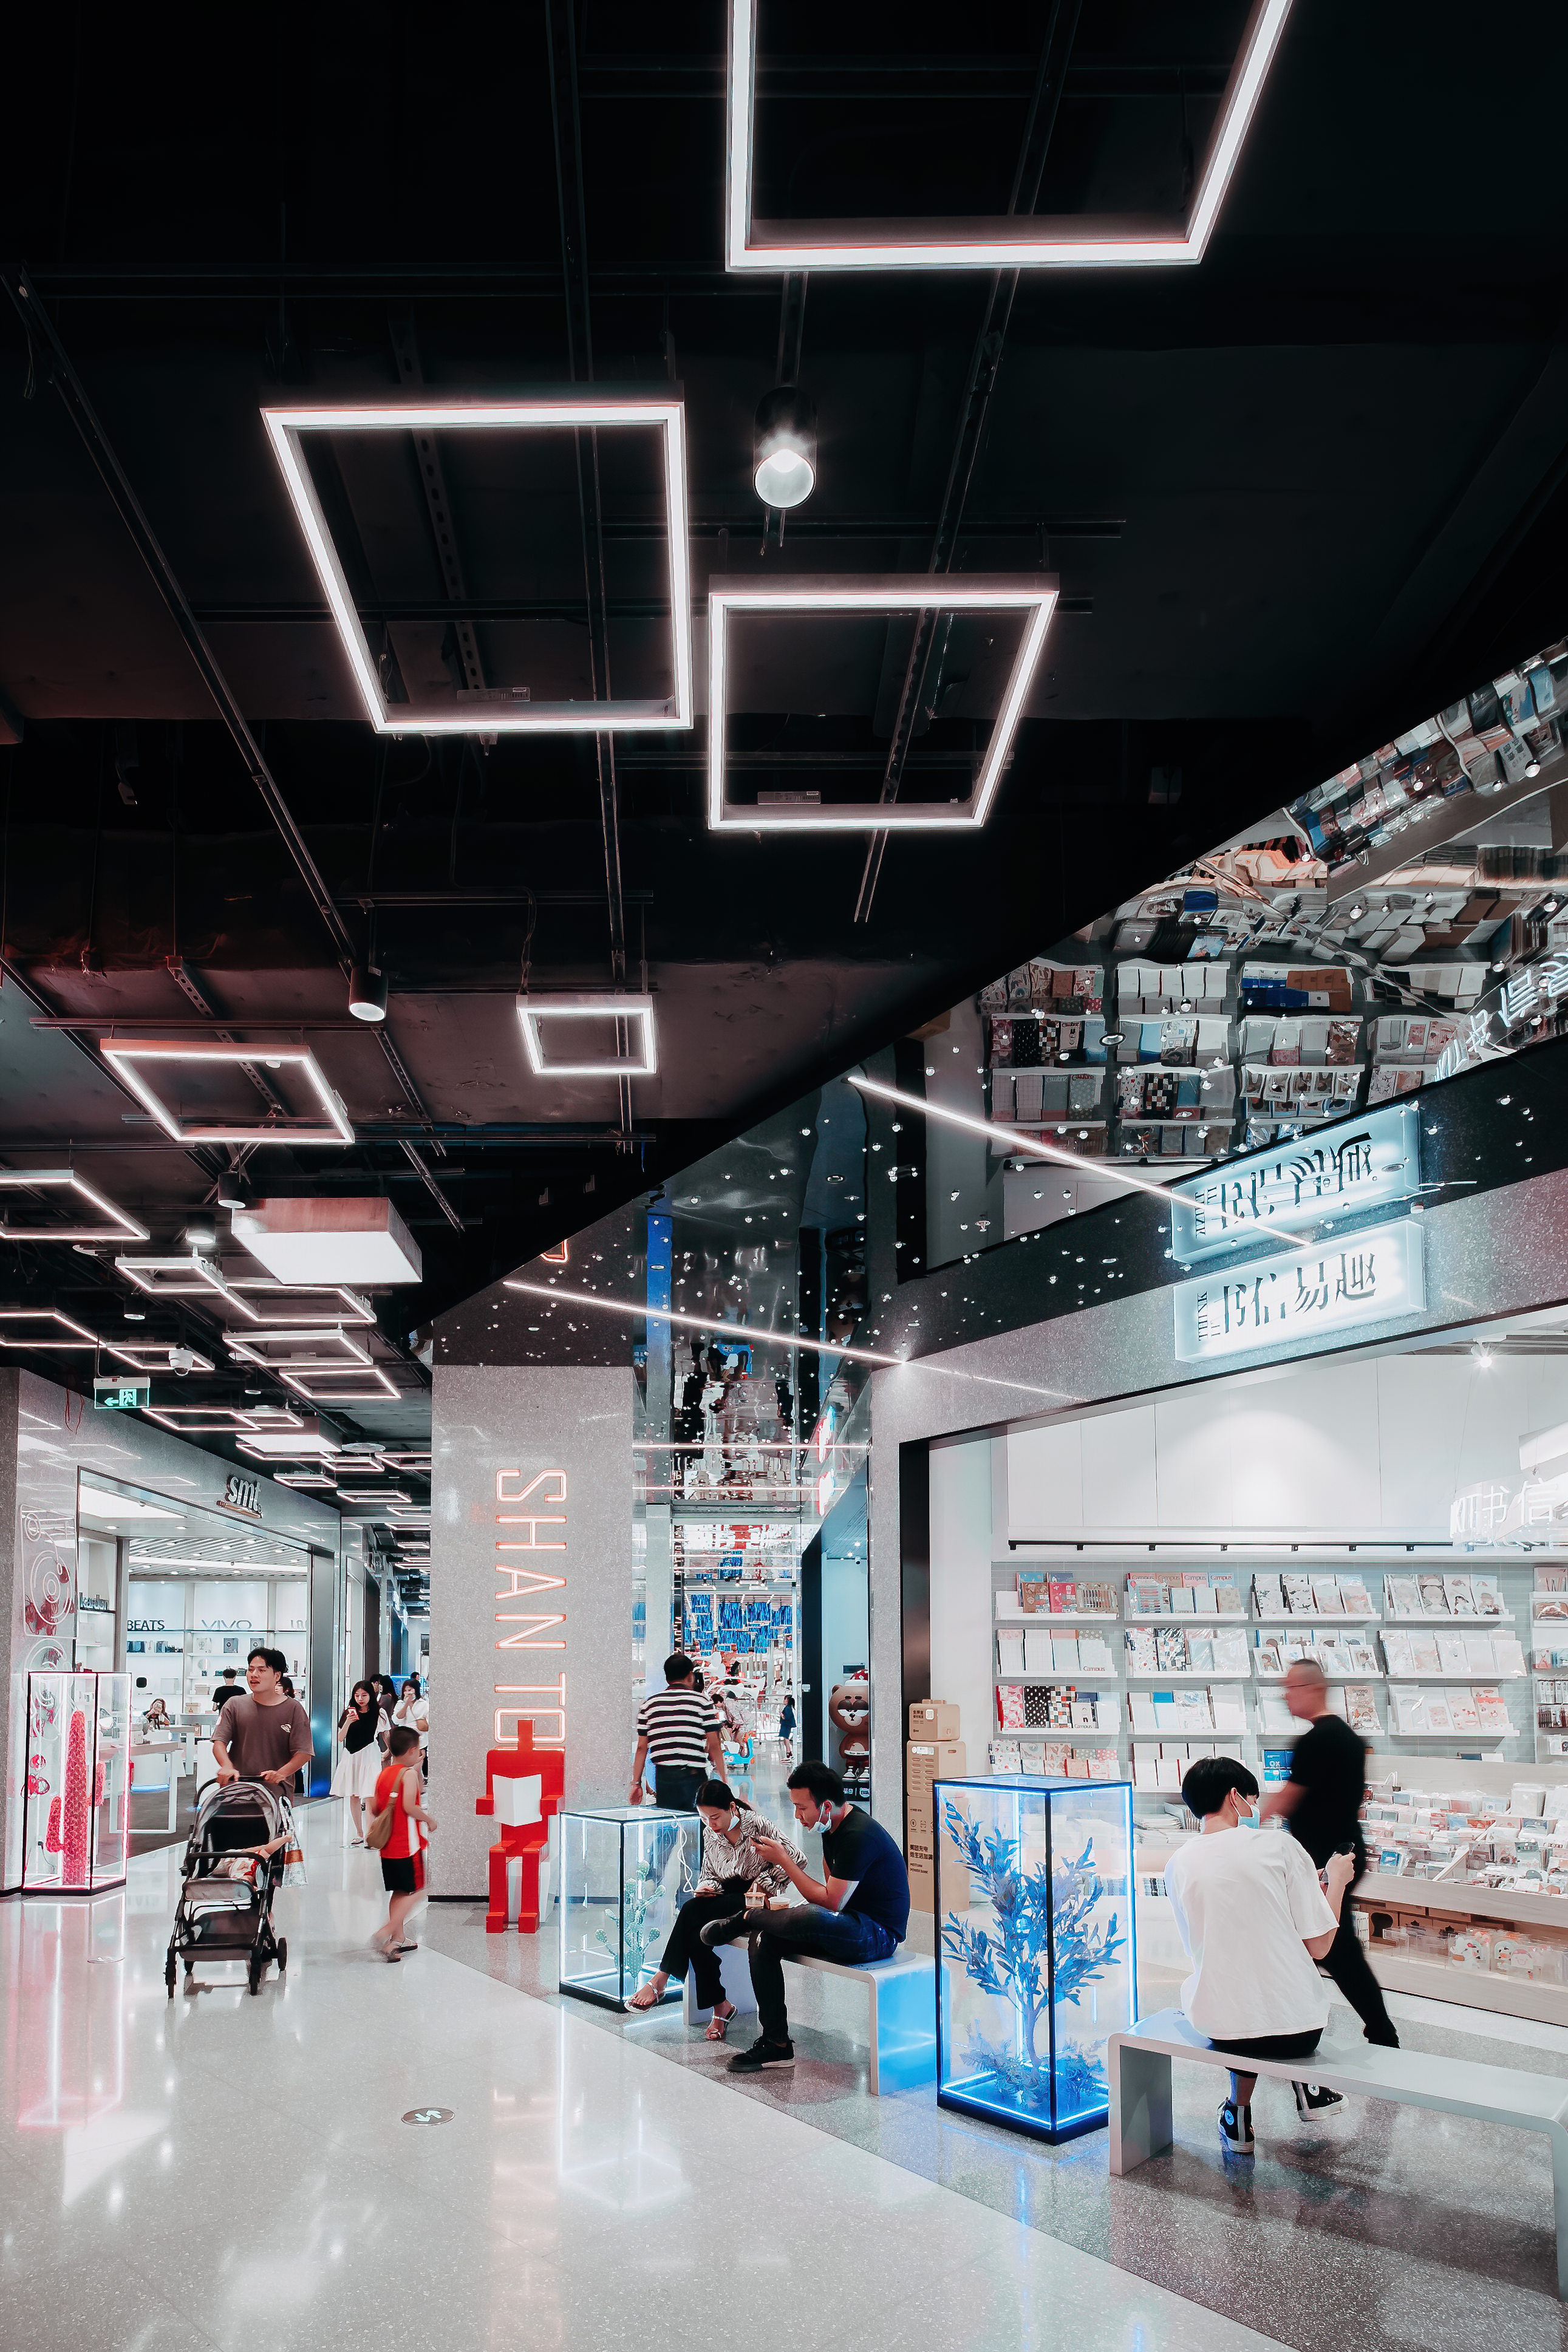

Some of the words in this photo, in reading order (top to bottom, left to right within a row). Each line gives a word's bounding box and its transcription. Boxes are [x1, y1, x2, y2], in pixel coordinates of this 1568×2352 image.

[1197, 1290, 1208, 1341] THINK
[201, 1620, 252, 1629] VIVO
[494, 1671, 567, 1751] TO
